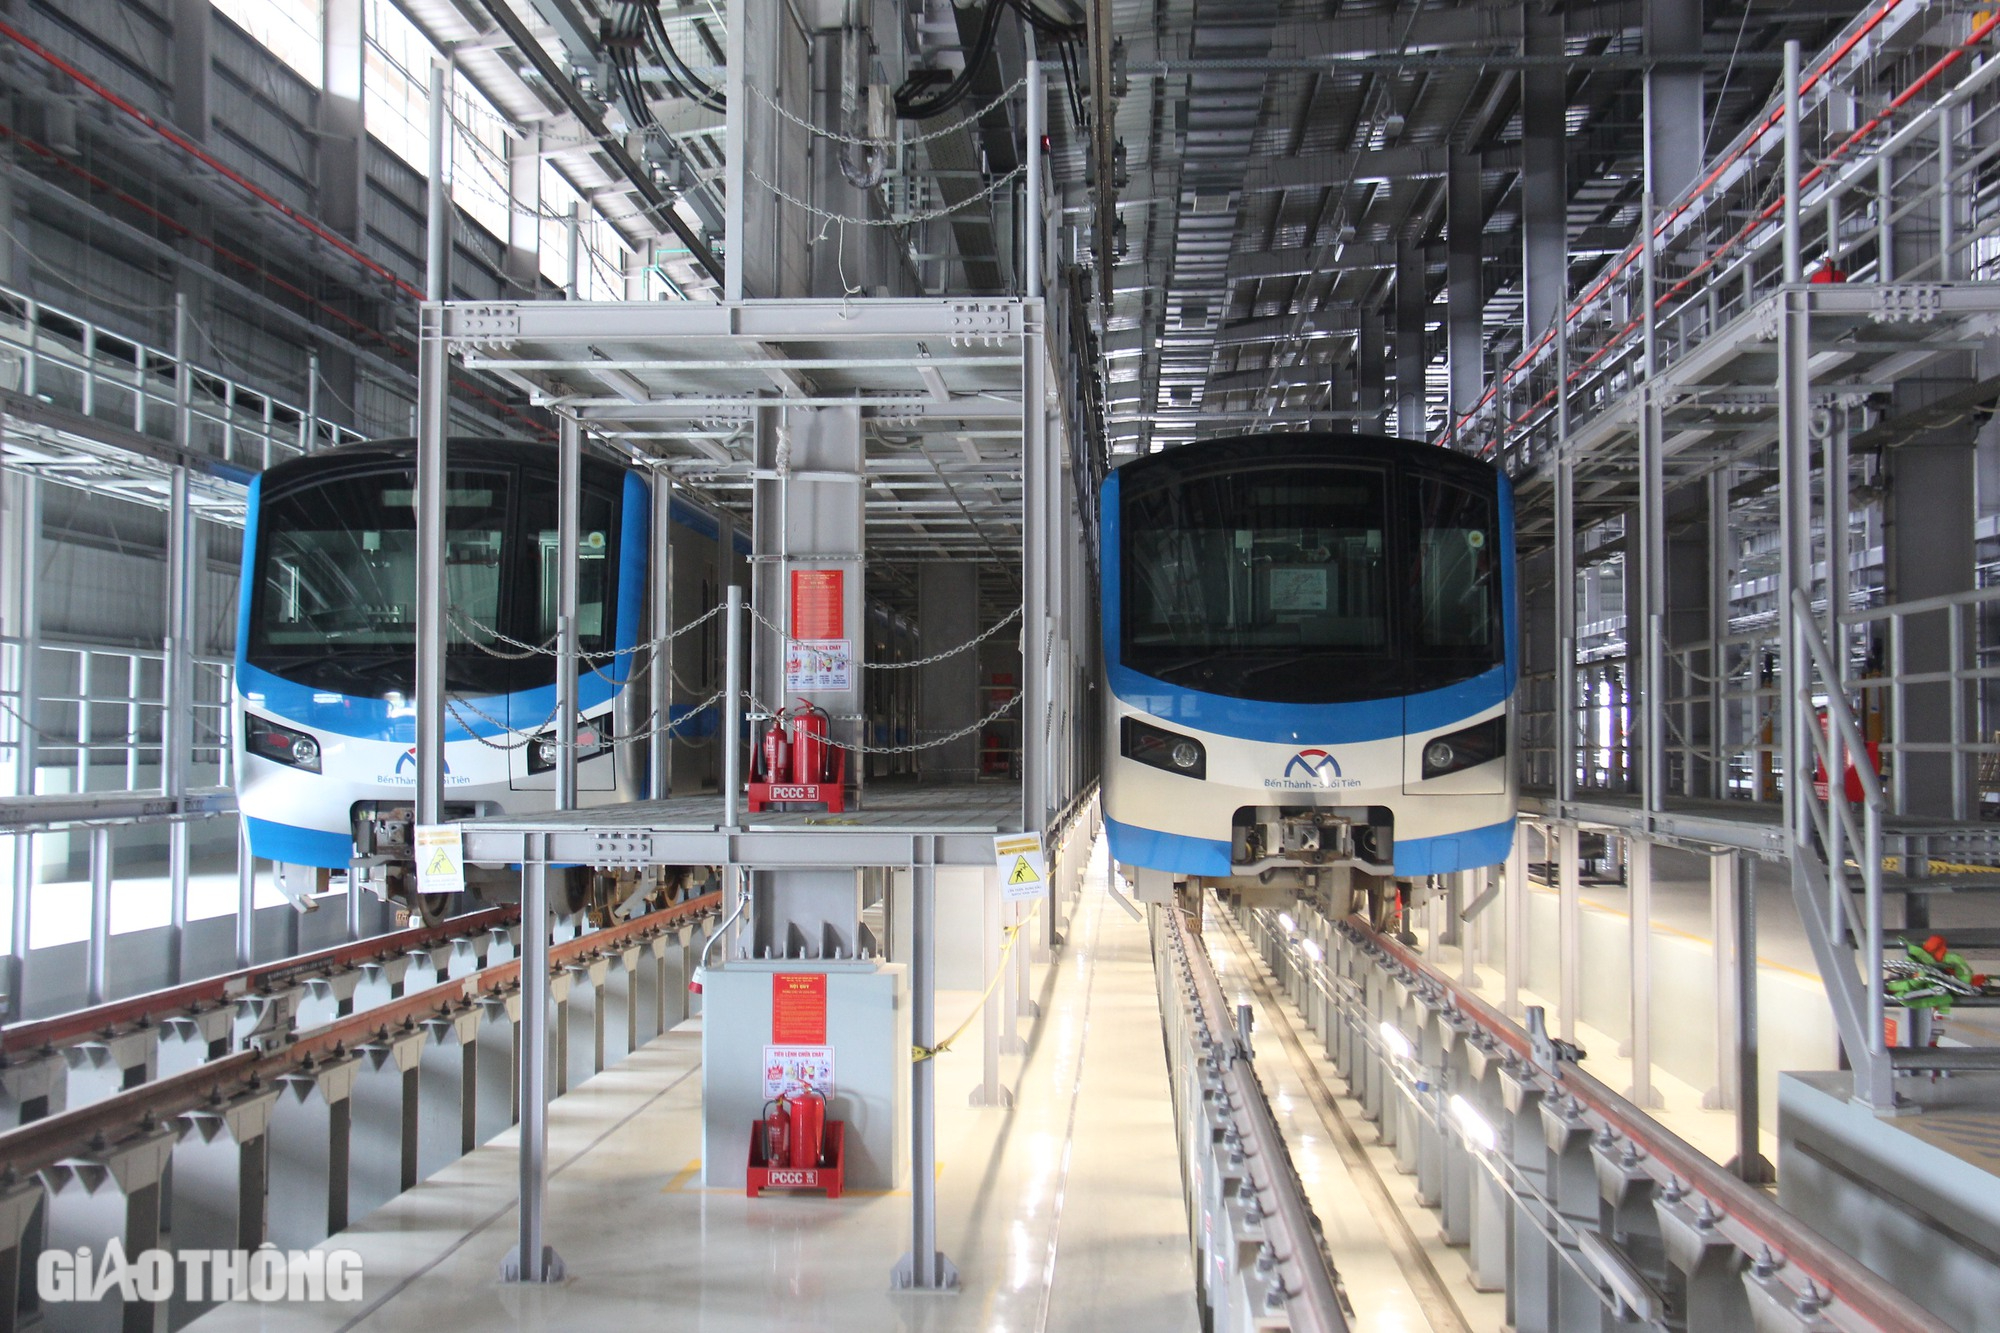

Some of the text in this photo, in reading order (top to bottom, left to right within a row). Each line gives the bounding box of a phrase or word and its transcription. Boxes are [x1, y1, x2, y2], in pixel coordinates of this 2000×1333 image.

[377, 774, 394, 784] Bến
[395, 776, 416, 785] Thàn
[451, 775, 470, 784] Tiên
[1264, 778, 1281, 788] Bến
[1284, 779, 1311, 789] Thành
[1342, 778, 1361, 788] Tiên
[773, 787, 804, 799] PCCC
[771, 1172, 803, 1184] PCCC
